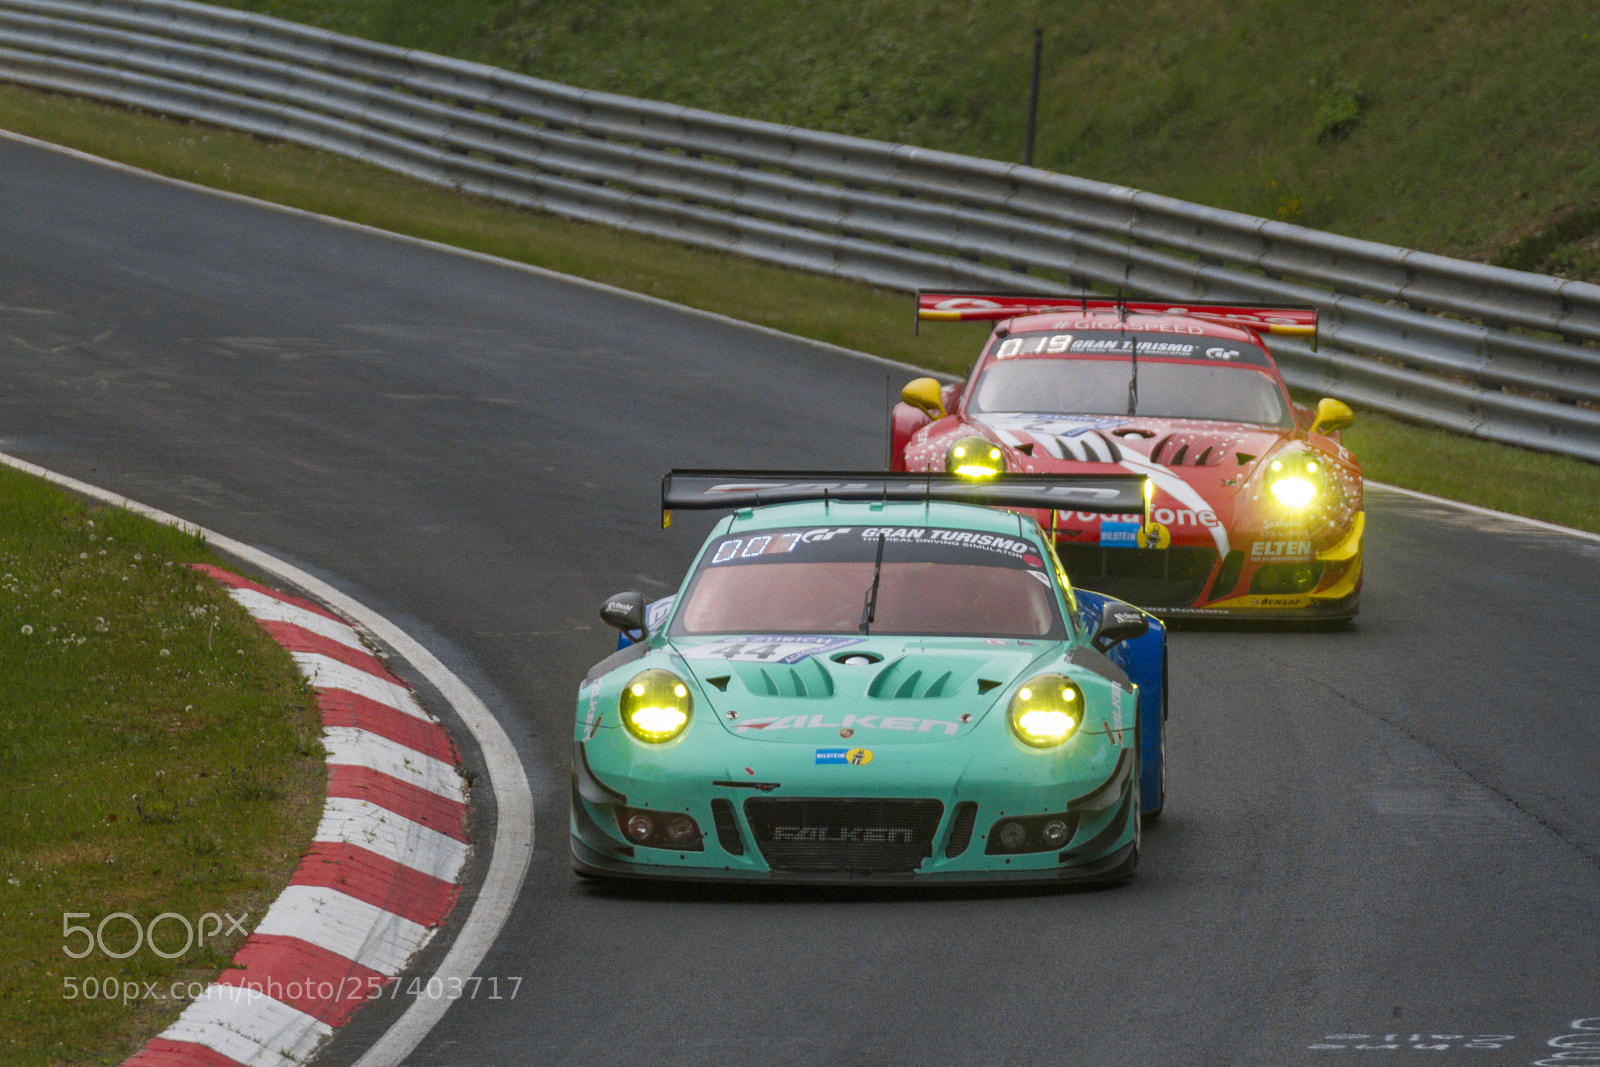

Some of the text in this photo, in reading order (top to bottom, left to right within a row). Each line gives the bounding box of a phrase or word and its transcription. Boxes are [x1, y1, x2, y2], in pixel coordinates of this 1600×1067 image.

[1071, 339, 1119, 349] GRAN
[1058, 503, 1218, 526] voaone
[861, 527, 1028, 554] GRAN TURISMO
[1101, 530, 1136, 541] BILSTEIN
[915, 538, 960, 546] DRIVING
[962, 542, 1023, 560] SIMULATOR
[1251, 541, 1311, 555] ELTEN
[1260, 597, 1301, 605] DUNLOP
[710, 643, 782, 660] 44
[730, 714, 960, 736] FALKEN
[816, 752, 846, 760] BILSTEIN
[773, 826, 914, 843] FALKEN
